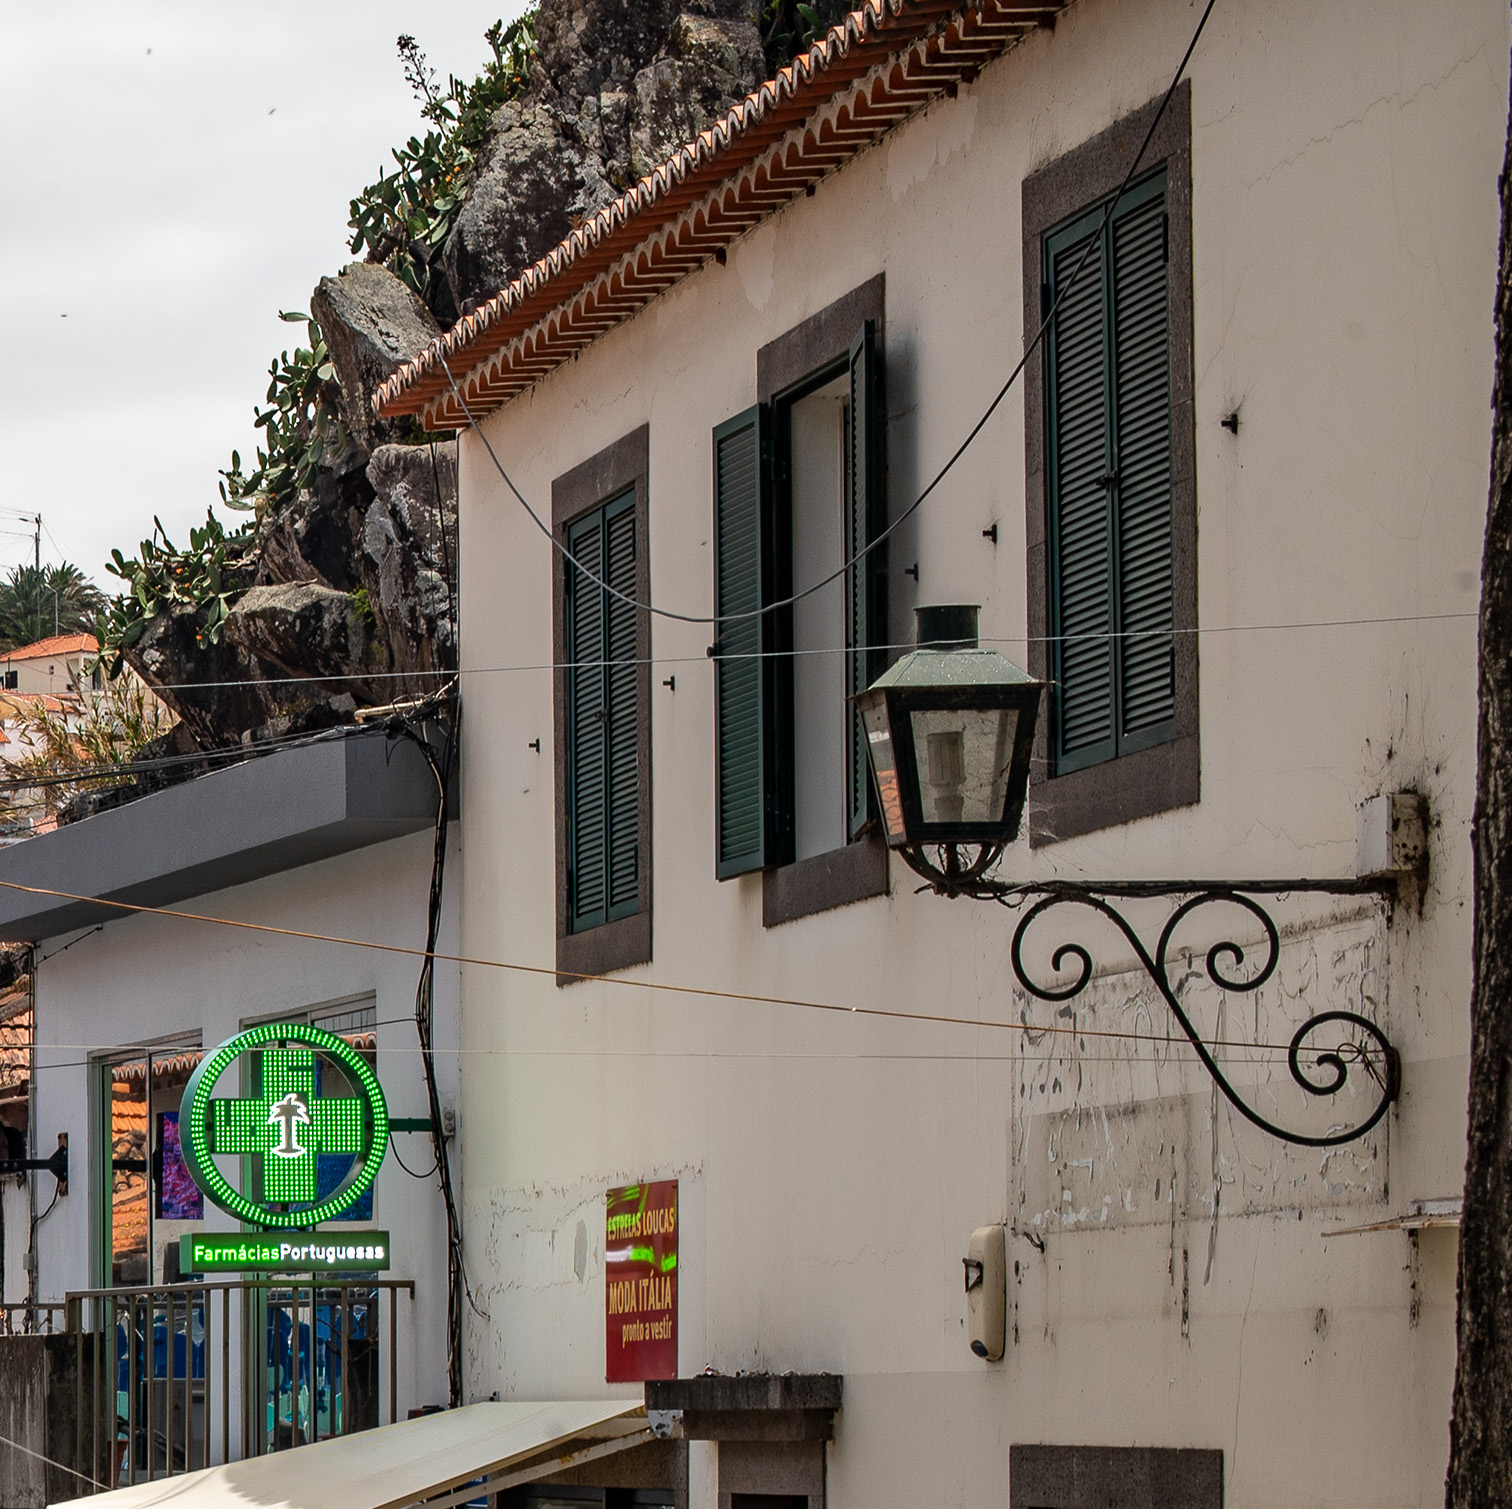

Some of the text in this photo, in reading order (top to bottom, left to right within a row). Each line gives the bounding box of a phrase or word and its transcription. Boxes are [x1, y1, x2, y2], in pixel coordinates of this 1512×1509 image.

[607, 1207, 674, 1241] ESTRELAS LOUCAS
[608, 1268, 672, 1315] MODA ITÁLIA
[622, 1314, 673, 1348] pronto a vestir
